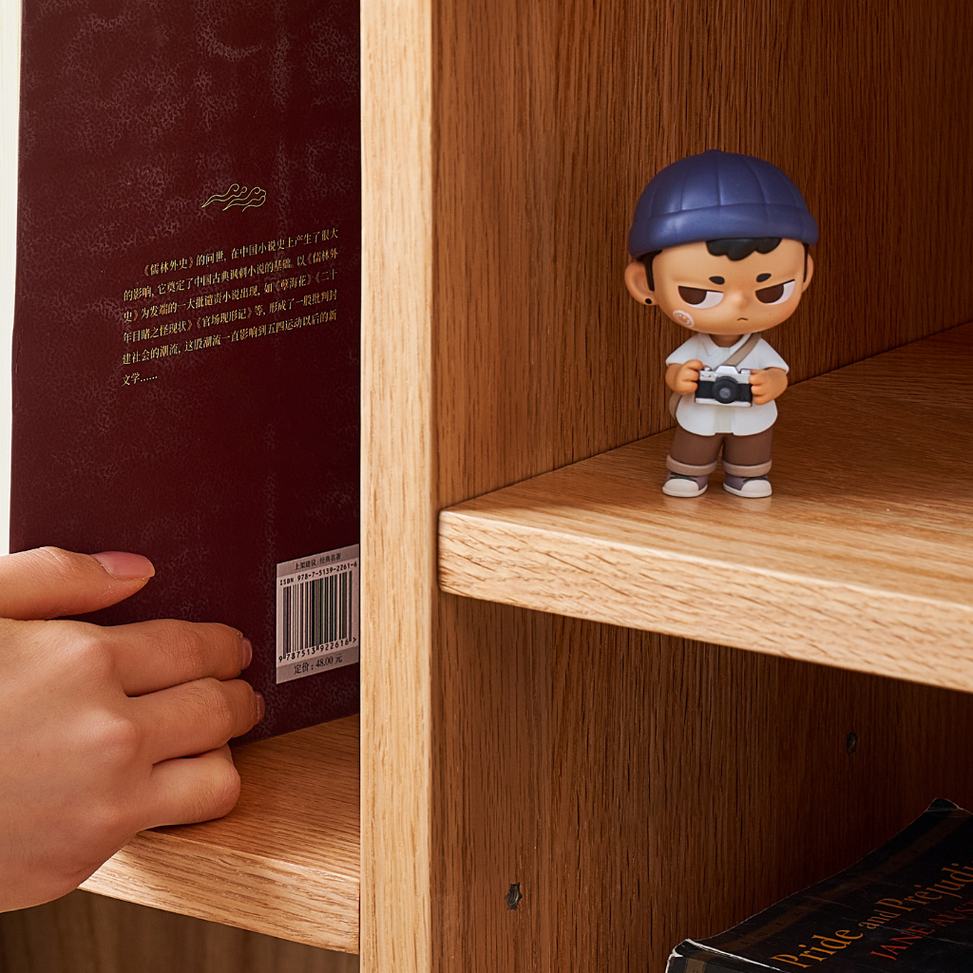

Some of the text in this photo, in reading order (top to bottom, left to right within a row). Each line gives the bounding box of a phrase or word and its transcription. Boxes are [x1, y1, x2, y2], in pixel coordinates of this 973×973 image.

[279, 561, 358, 586] ISBN 978-7-5139-2261-6
[769, 929, 864, 969] Pride
[858, 910, 901, 930] and
[870, 925, 936, 962] JANE
